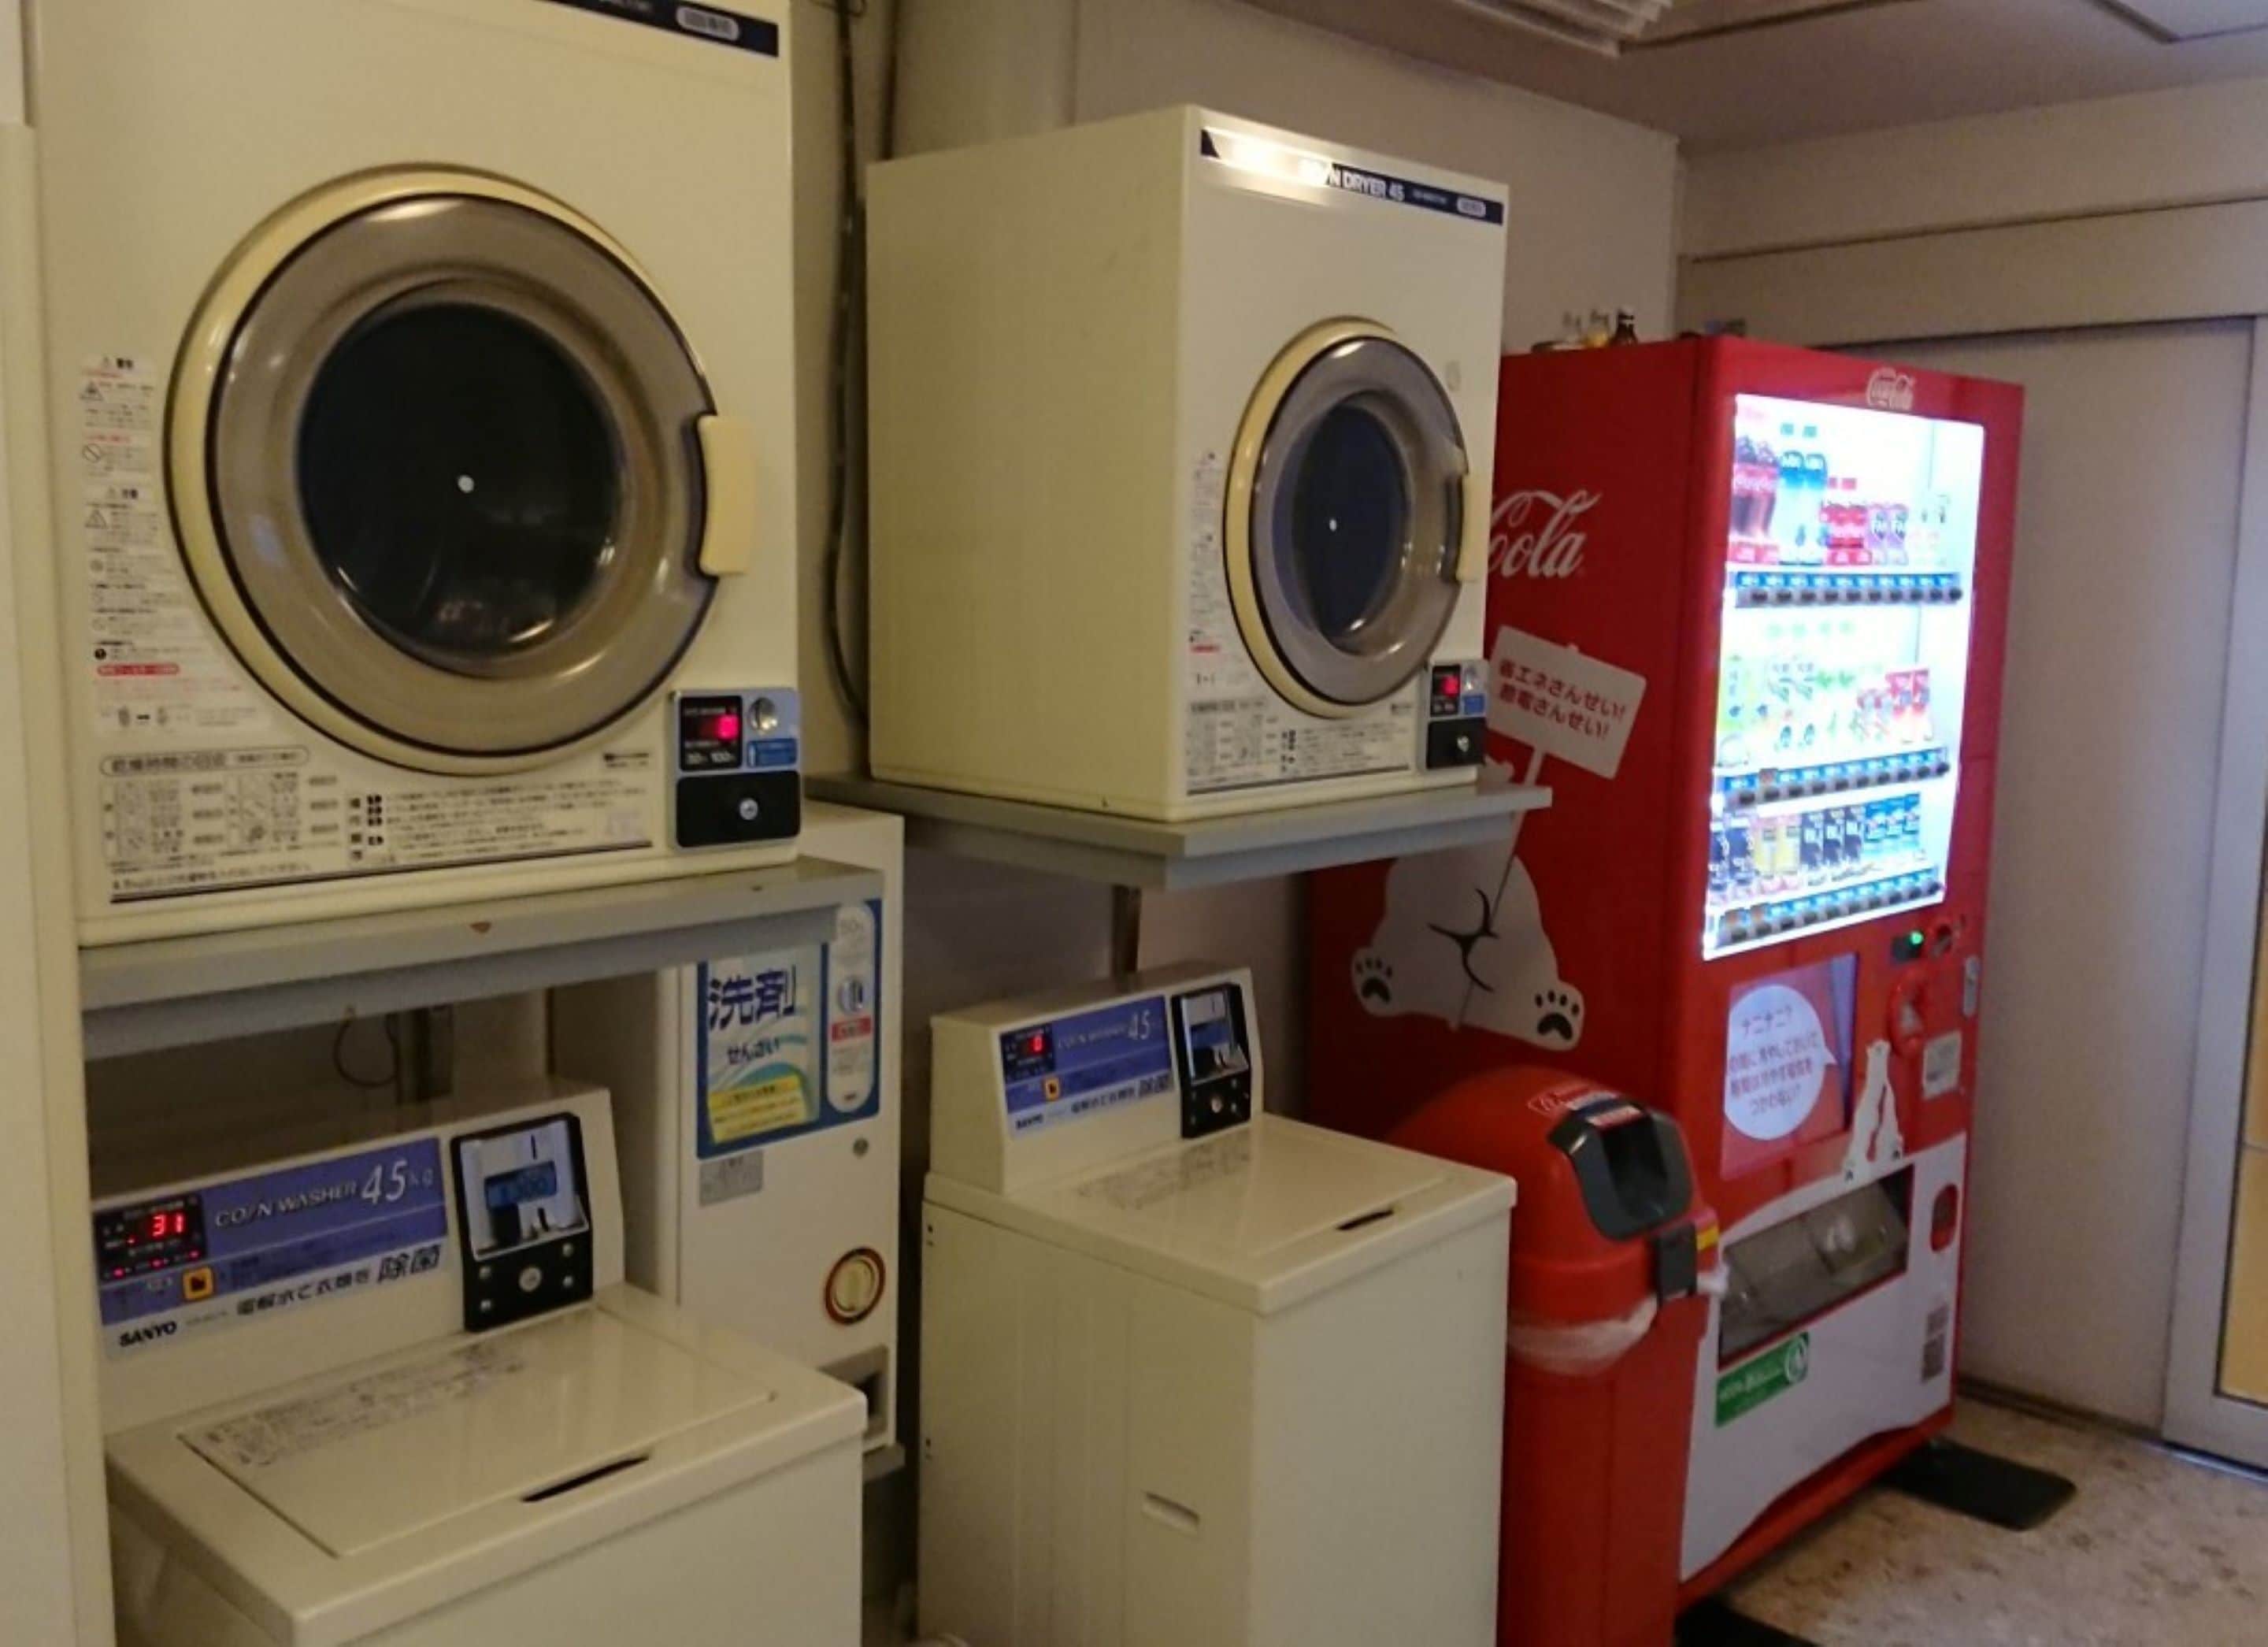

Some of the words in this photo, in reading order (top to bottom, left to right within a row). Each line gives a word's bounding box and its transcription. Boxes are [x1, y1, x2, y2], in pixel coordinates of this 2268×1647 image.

[1343, 171, 1386, 199] DRYER
[708, 963, 797, 1031] 洗剤
[1127, 1009, 1151, 1041] 45
[278, 1180, 358, 1214] WASHER
[361, 1159, 408, 1205] 45
[152, 1213, 184, 1238] 31
[119, 1320, 177, 1348] SANYO
